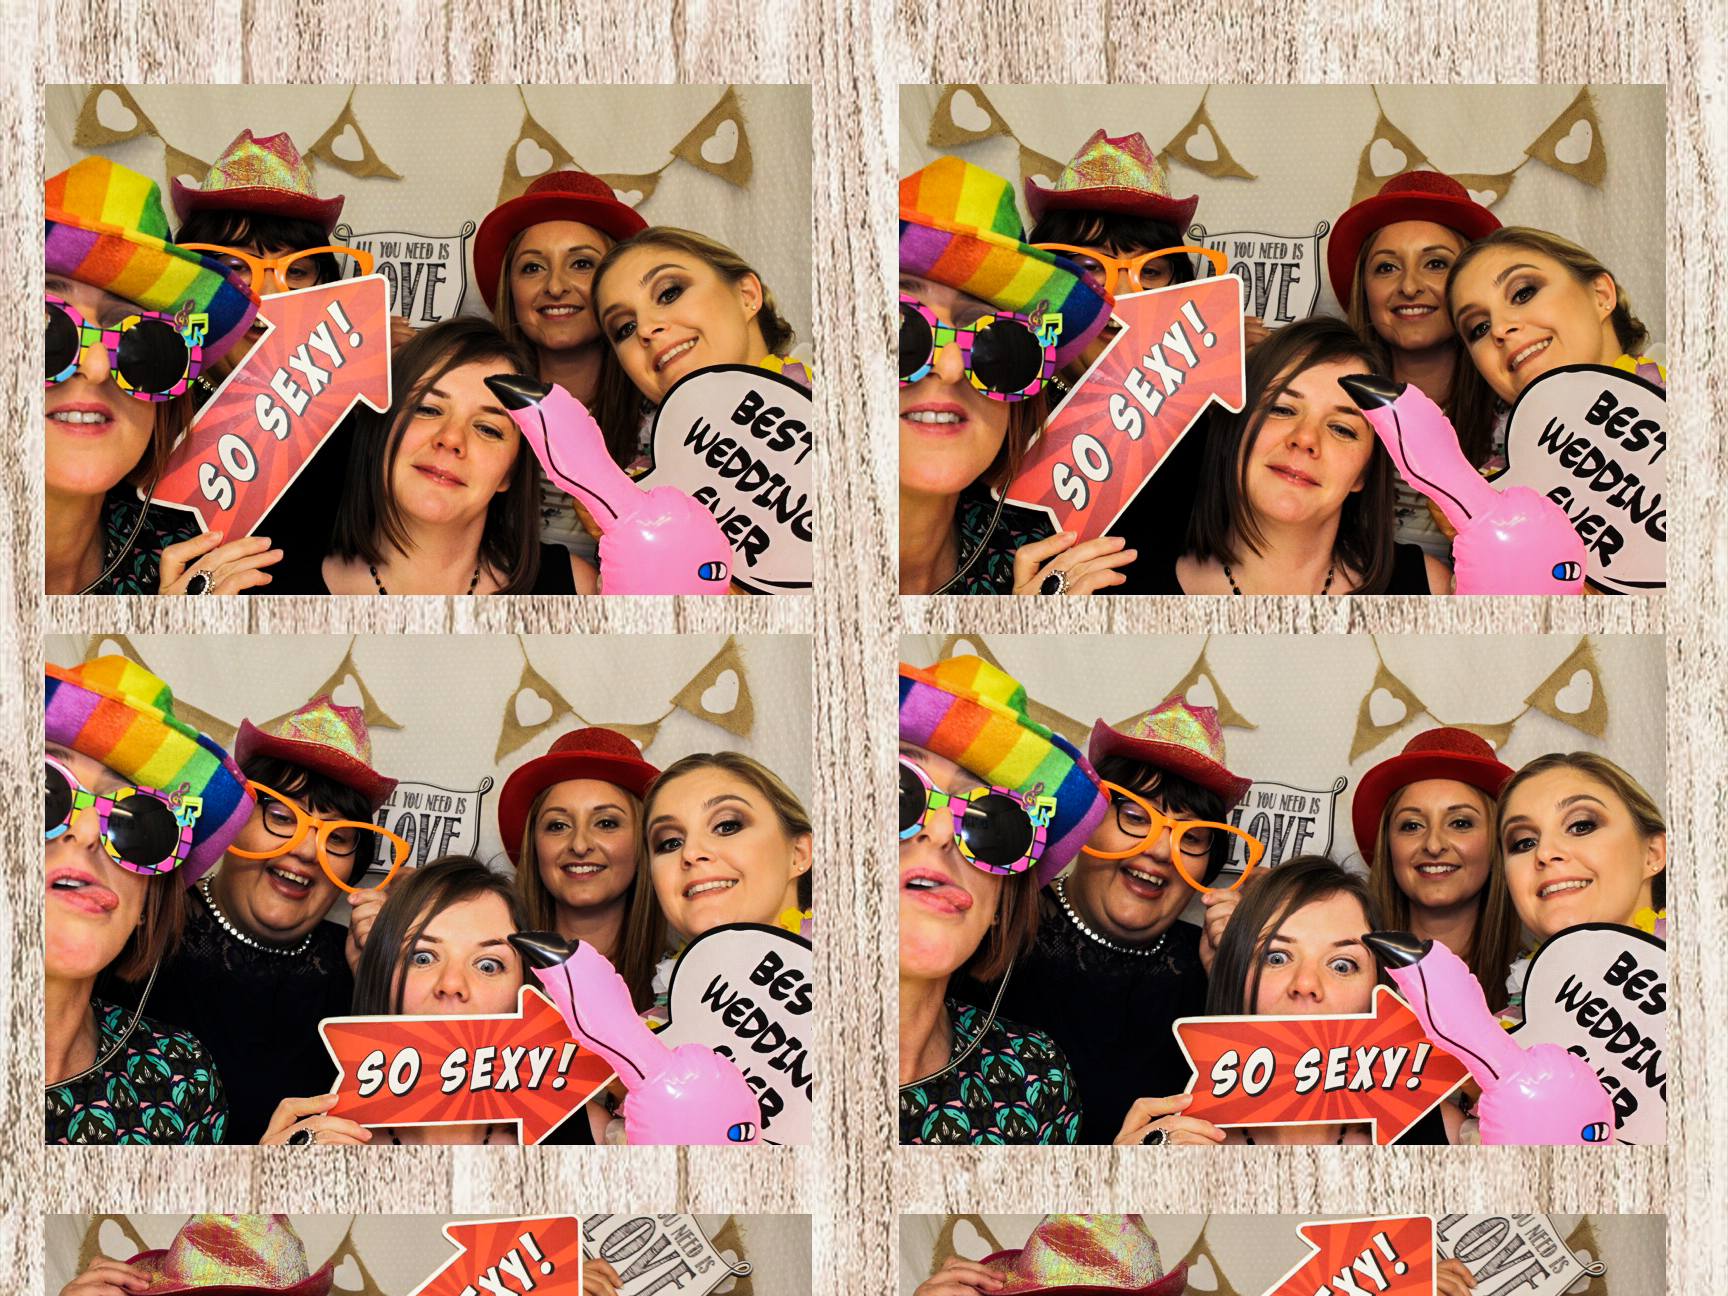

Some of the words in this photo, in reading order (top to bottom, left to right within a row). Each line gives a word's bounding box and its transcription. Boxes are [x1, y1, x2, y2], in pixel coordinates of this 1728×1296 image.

[380, 241, 401, 259] YOU
[405, 242, 434, 260] NEED
[438, 243, 450, 260] IS
[1234, 241, 1255, 259] YOU
[1259, 242, 1288, 260] NEED
[1292, 243, 1304, 260] IS
[352, 260, 447, 323] OVE
[1206, 260, 1301, 323] OVE
[198, 433, 260, 511] SO
[254, 299, 364, 441] SEXY!
[1052, 433, 1114, 511] SO
[1108, 299, 1218, 441] SEXY!
[383, 790, 398, 807] LL
[402, 791, 424, 809] YOU
[425, 793, 453, 813] NEED
[454, 797, 468, 814] IS
[1237, 790, 1252, 807] LL
[1256, 791, 1278, 809] YOU
[1279, 793, 1307, 813] NEED
[1308, 797, 1322, 814] IS
[700, 974, 812, 1104] WEDDIN
[1554, 974, 1666, 1104] WEDDIN
[356, 1046, 423, 1098] SO
[439, 1042, 578, 1096] SEXY!
[1210, 1046, 1277, 1098] SO
[1293, 1042, 1432, 1096] SEXY!
[670, 1223, 704, 1259] NEED
[694, 1255, 716, 1275] IS
[1524, 1223, 1558, 1259] NEED
[1548, 1255, 1570, 1275] IS
